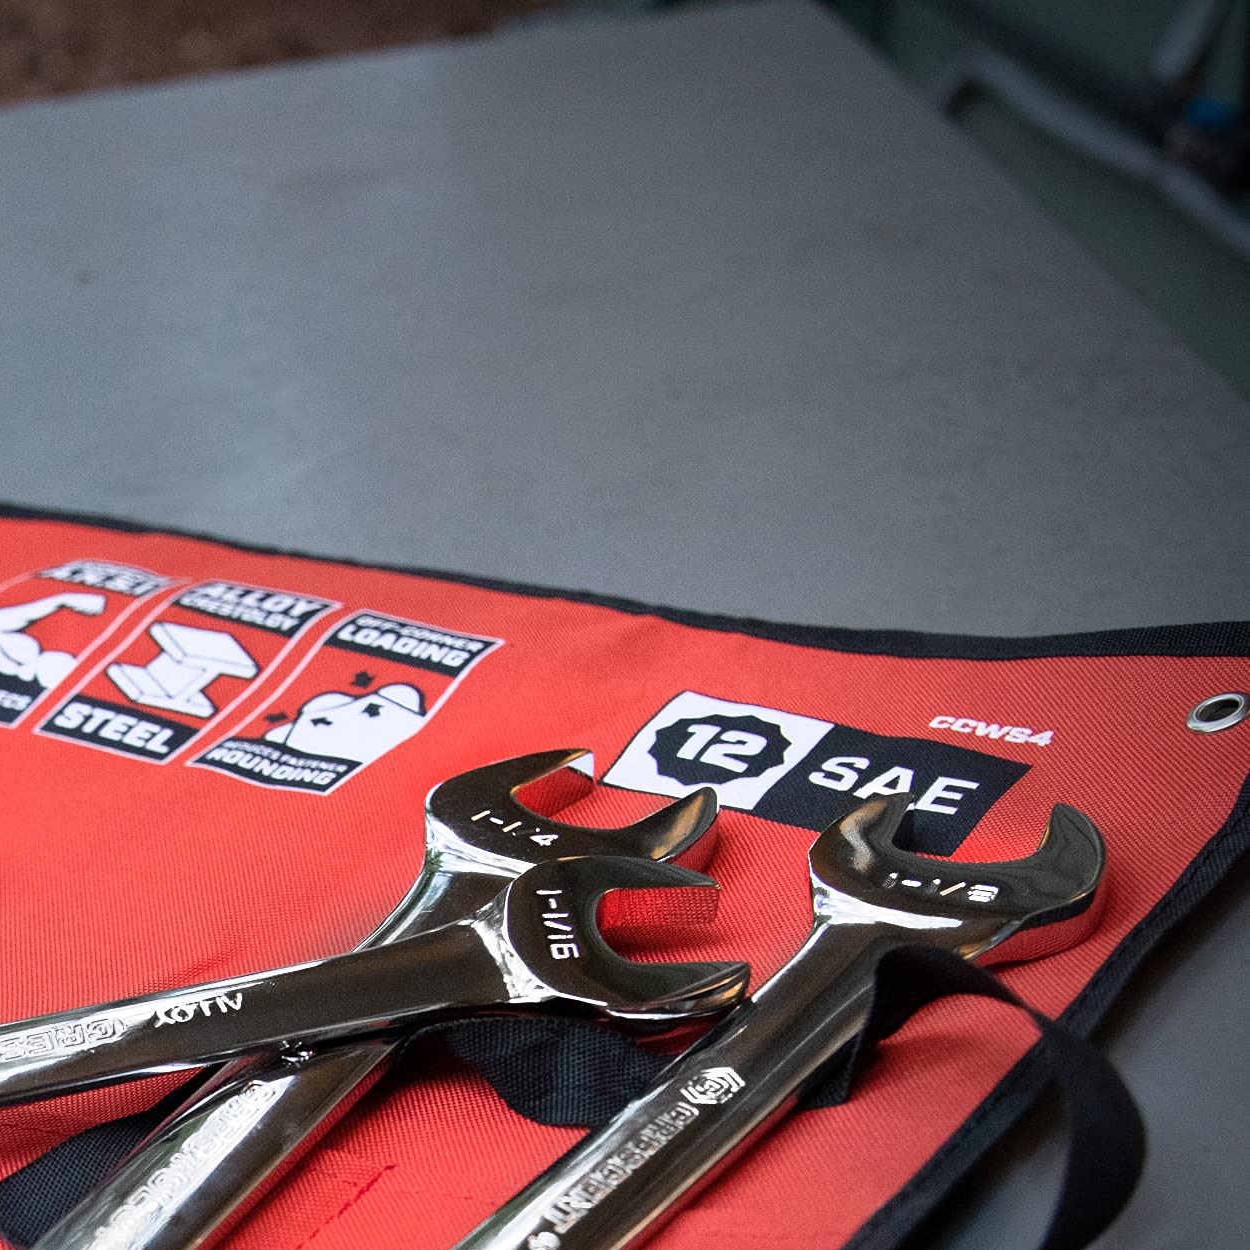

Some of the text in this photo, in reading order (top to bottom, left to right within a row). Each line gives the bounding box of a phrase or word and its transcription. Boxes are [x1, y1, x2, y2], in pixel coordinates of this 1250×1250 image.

[336, 623, 471, 668] LOADING
[53, 701, 176, 754] STEEL
[928, 715, 1055, 748] CCWS4
[205, 748, 338, 786] ROUNDING
[676, 723, 981, 816] 12 SAE
[535, 888, 579, 960] 1-1/16
[153, 992, 243, 1028] ALLOY
